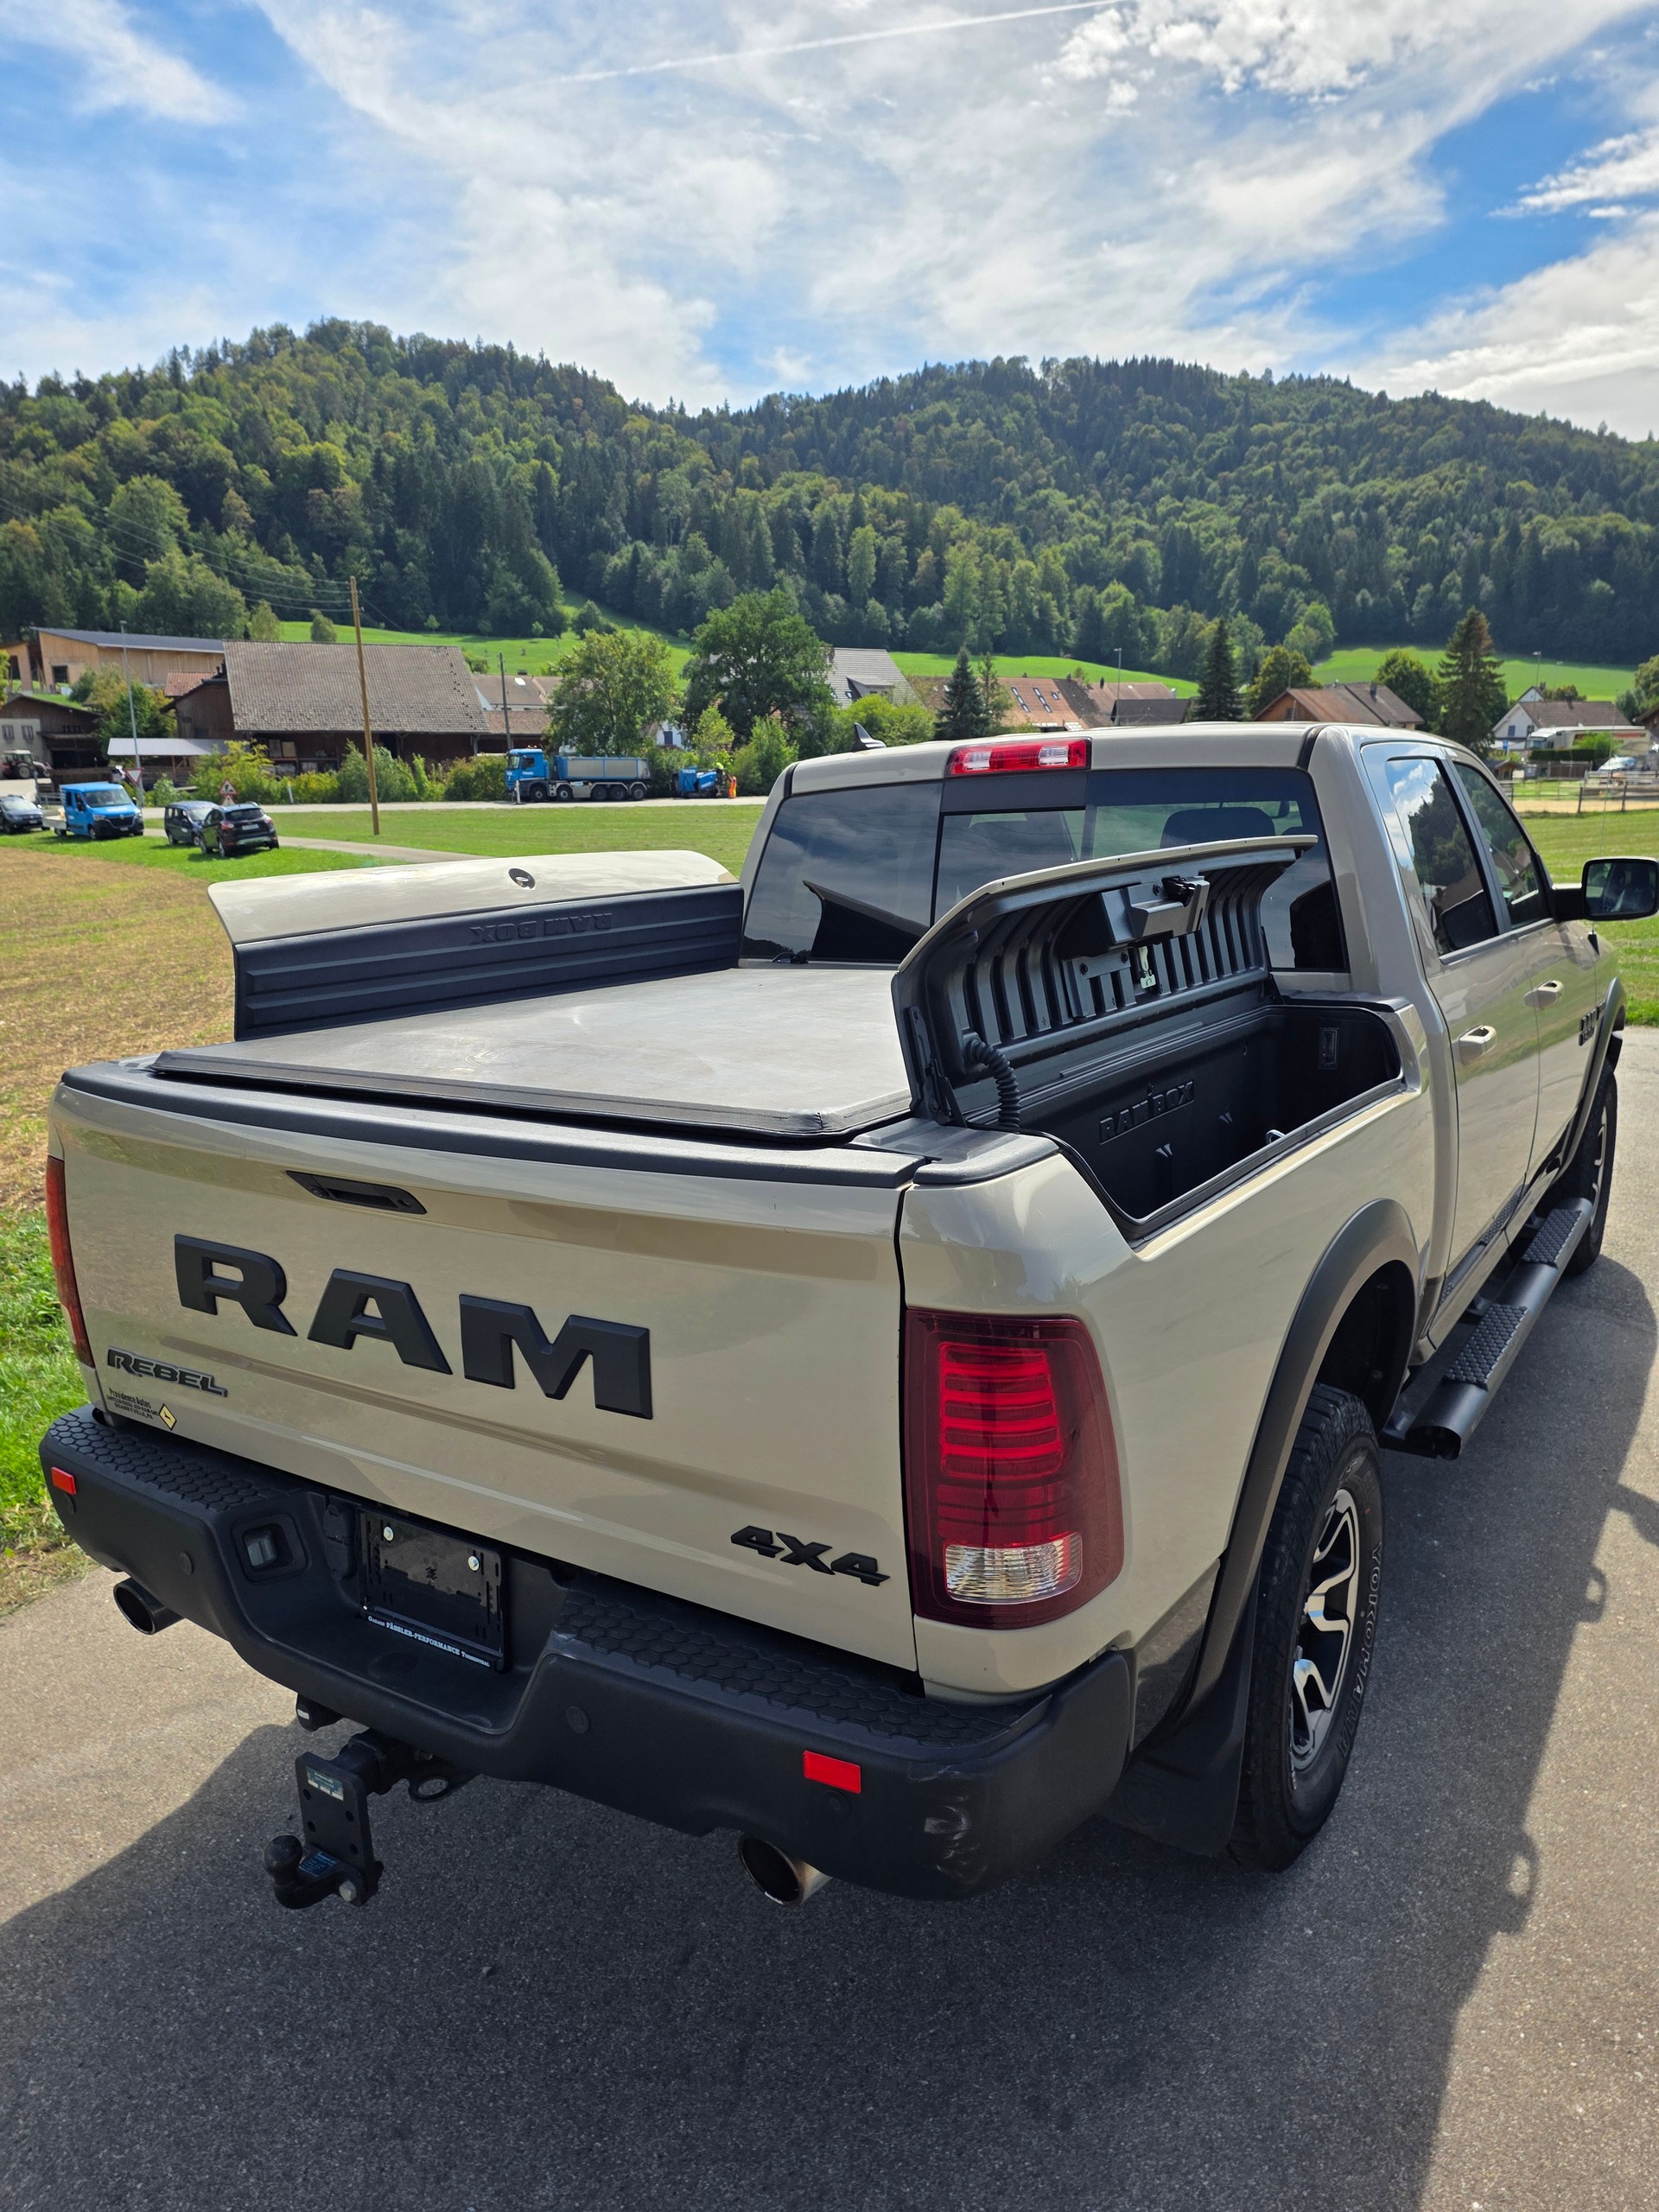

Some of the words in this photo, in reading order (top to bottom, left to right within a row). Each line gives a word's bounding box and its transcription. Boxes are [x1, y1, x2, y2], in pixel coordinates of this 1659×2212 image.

[107, 1345, 228, 1397] REBEL
[175, 1234, 653, 1420] RAM
[730, 1525, 891, 1587] 4X4
[1337, 1541, 1382, 1757] YOKOHAMA
